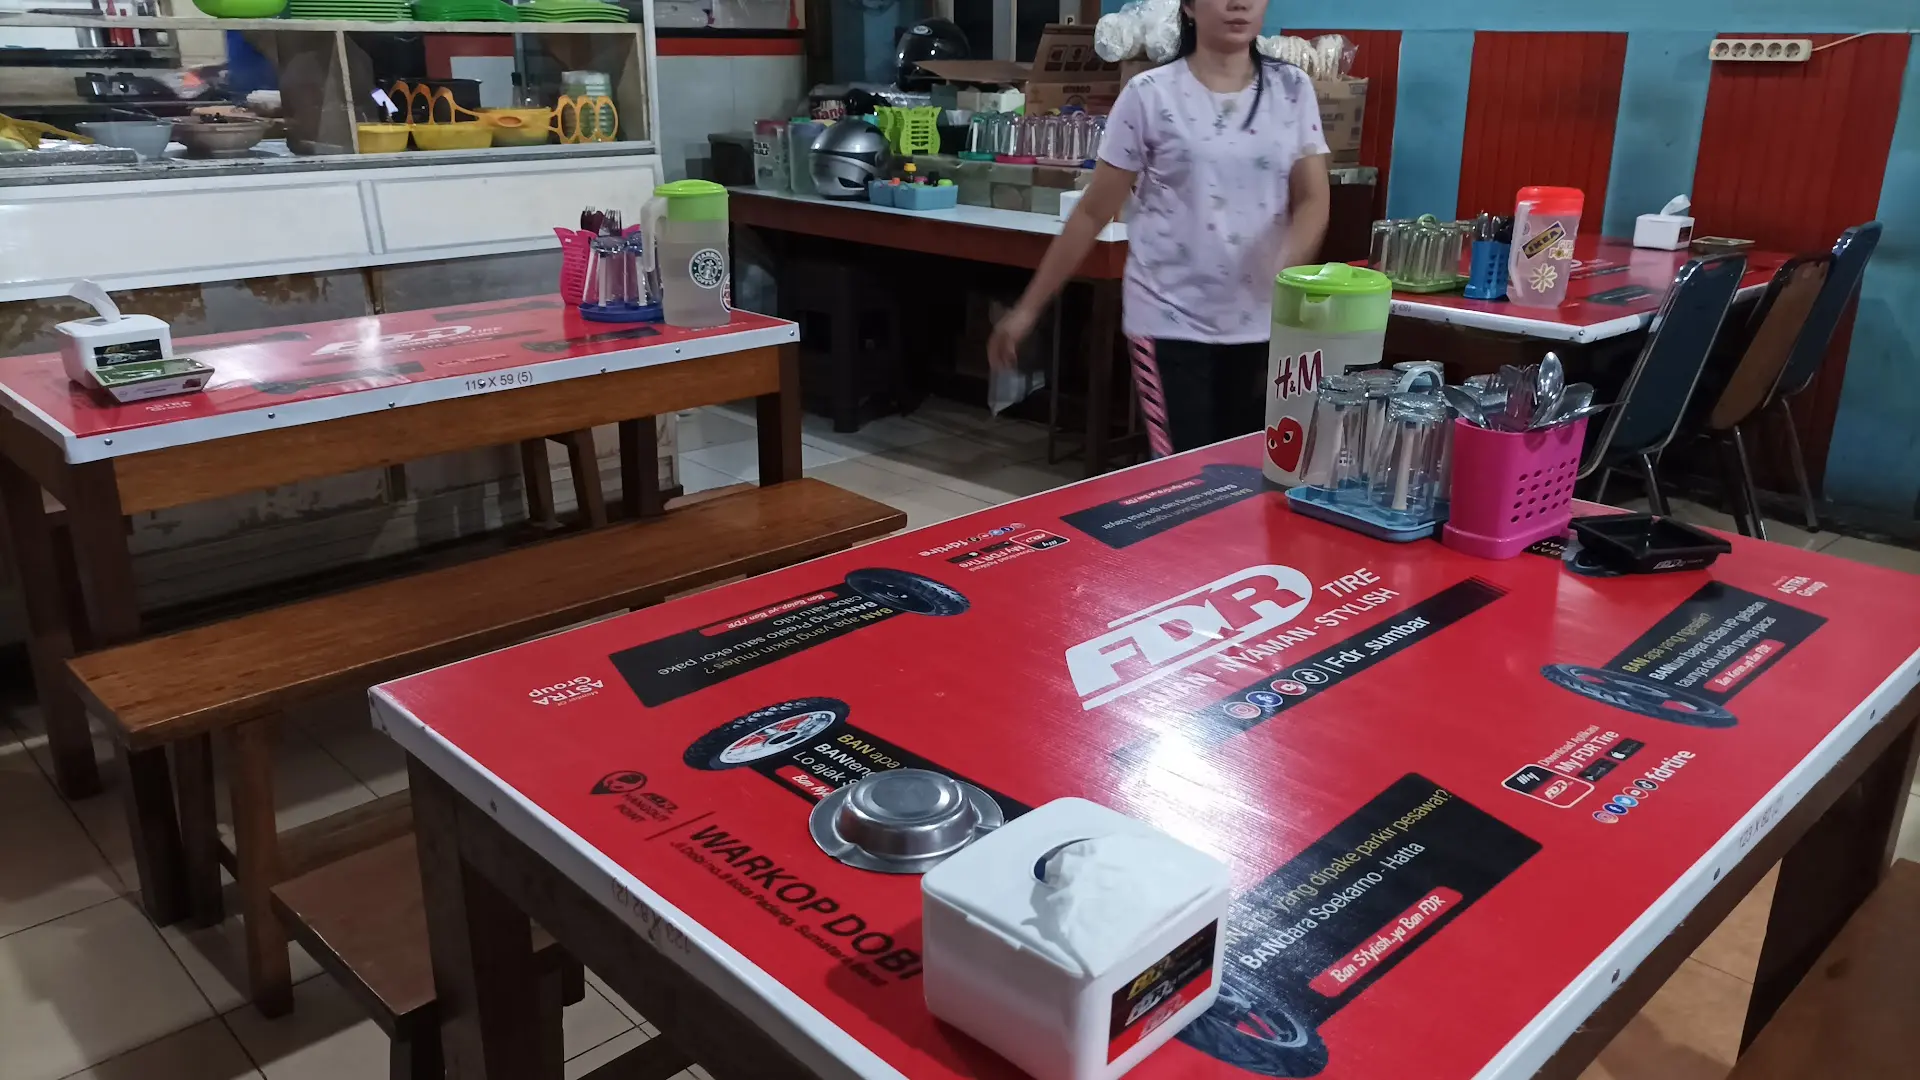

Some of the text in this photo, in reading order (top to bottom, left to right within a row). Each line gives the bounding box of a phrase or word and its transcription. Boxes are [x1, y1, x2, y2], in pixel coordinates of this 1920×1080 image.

[1528, 230, 1559, 252] IKEA
[500, 374, 514, 386] 59
[517, 371, 534, 384] (5)
[1274, 350, 1324, 400] H&M
[727, 617, 748, 629] FDR
[772, 595, 863, 626] cabe satu kilo
[834, 616, 860, 630] apa
[859, 607, 894, 622] BAN
[658, 601, 878, 676] BANdeng Presto satu ekor pake
[760, 636, 801, 654] bikin
[801, 622, 835, 641] yang
[1065, 565, 1381, 711] FDR TIRE
[1216, 626, 1318, 673] NYAMAN
[1319, 587, 1400, 628] STYLISH
[713, 649, 760, 670] mules
[1622, 651, 1650, 673] BAN
[528, 676, 592, 698] Group
[532, 680, 604, 705] ASTRA
[837, 734, 901, 769] BAN apa
[1538, 736, 1575, 767] Download
[1555, 755, 1576, 773] My
[1571, 740, 1602, 764] FDR
[1591, 730, 1620, 748] Tire
[1644, 749, 1697, 782] fdrtire
[812, 763, 847, 782] ajak
[1273, 882, 1318, 914] yang
[1309, 850, 1362, 889] dipake
[1354, 826, 1398, 857] parkir
[1392, 788, 1453, 832] pesawat?
[690, 825, 924, 981] WARKOP DOBI
[1239, 914, 1319, 971] BANdara
[1309, 871, 1383, 921] Soekarno
[1385, 840, 1426, 871] Hatta
[1330, 962, 1358, 985] Ban
[1398, 910, 1423, 932] Ban
[1417, 893, 1447, 918] FDR
